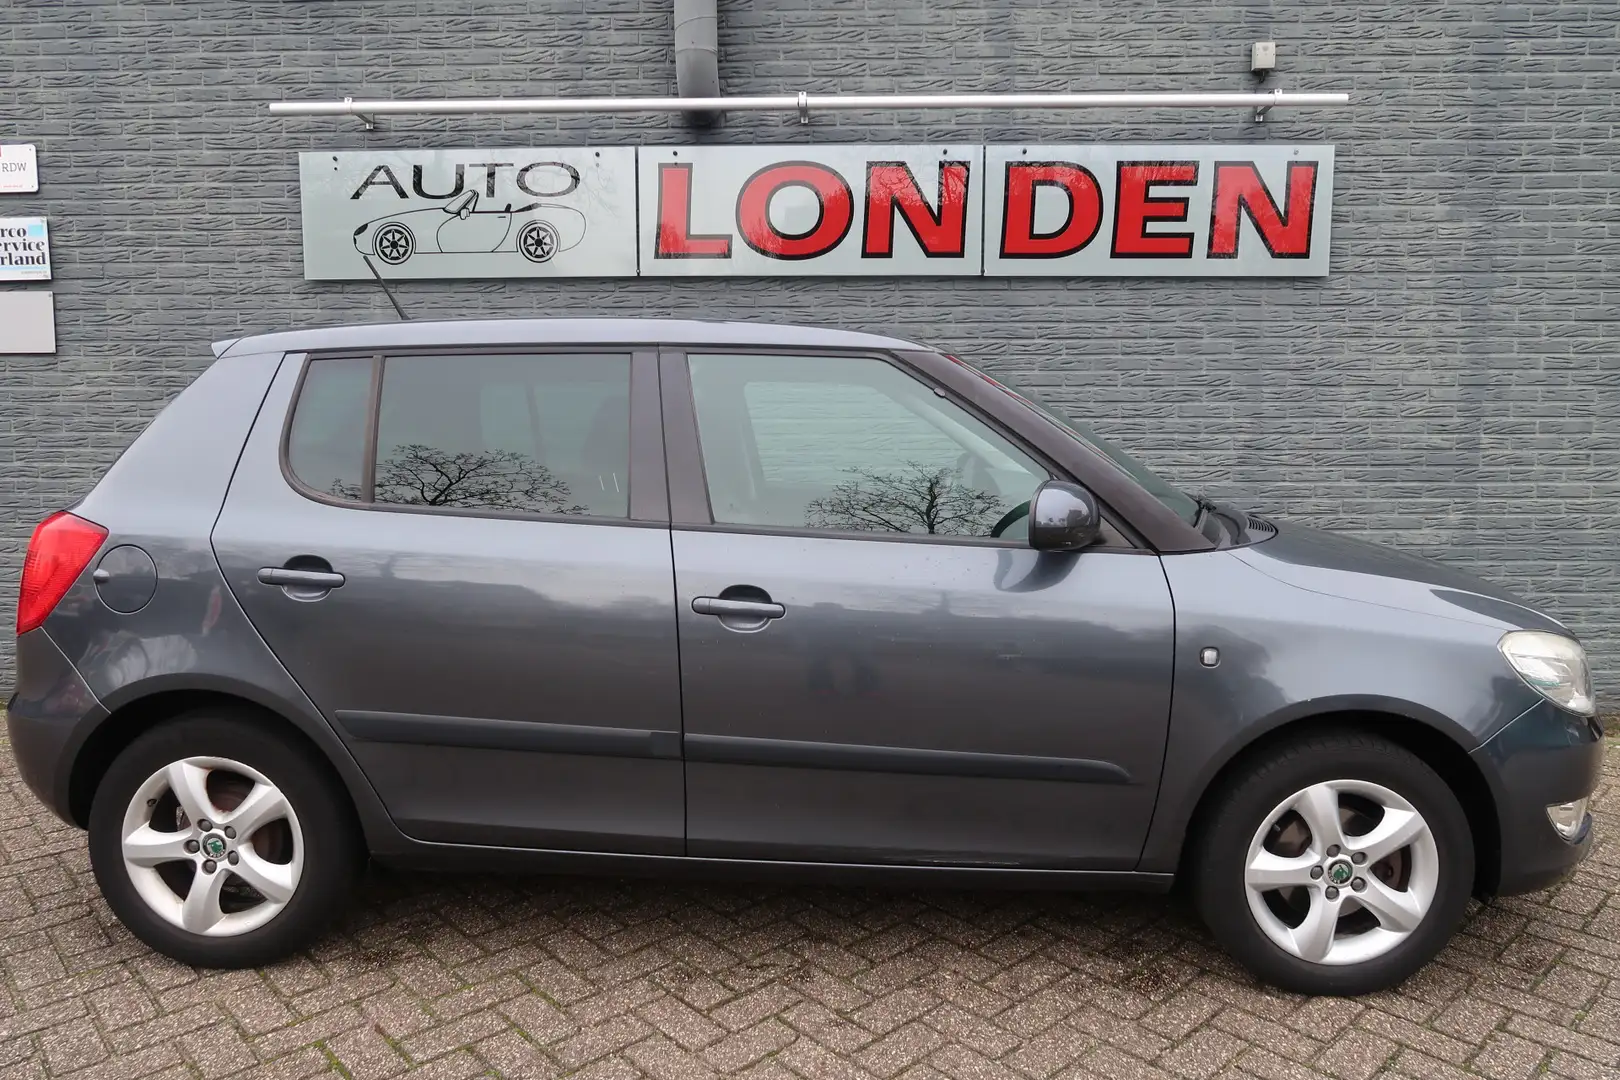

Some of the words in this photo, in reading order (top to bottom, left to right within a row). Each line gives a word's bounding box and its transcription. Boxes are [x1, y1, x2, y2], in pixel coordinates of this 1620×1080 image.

[2, 162, 27, 172] RDW
[350, 161, 580, 200] AUTO
[654, 160, 1319, 260] LONDEN
[0, 238, 45, 251] rvice
